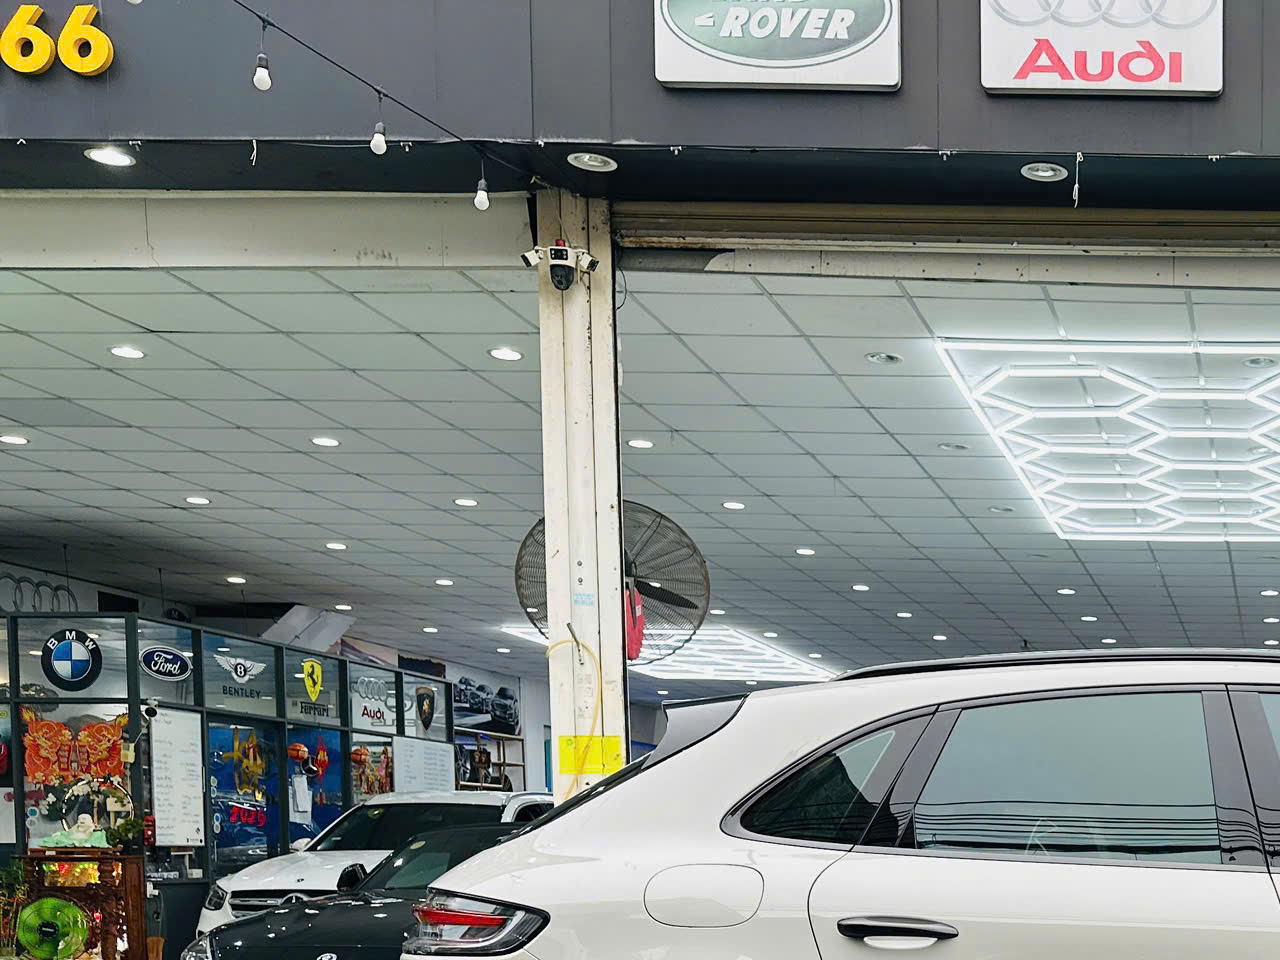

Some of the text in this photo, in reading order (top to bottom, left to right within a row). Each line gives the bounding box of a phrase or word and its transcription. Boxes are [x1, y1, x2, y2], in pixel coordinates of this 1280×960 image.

[719, 7, 856, 39] ROVER
[0, 4, 115, 76] 66
[1013, 38, 1183, 83] Audi
[47, 630, 97, 650] BMW
[150, 651, 182, 676] Ford
[222, 685, 261, 699] BENTLEY
[300, 701, 329, 717] Ferrari
[361, 705, 385, 721] Audi
